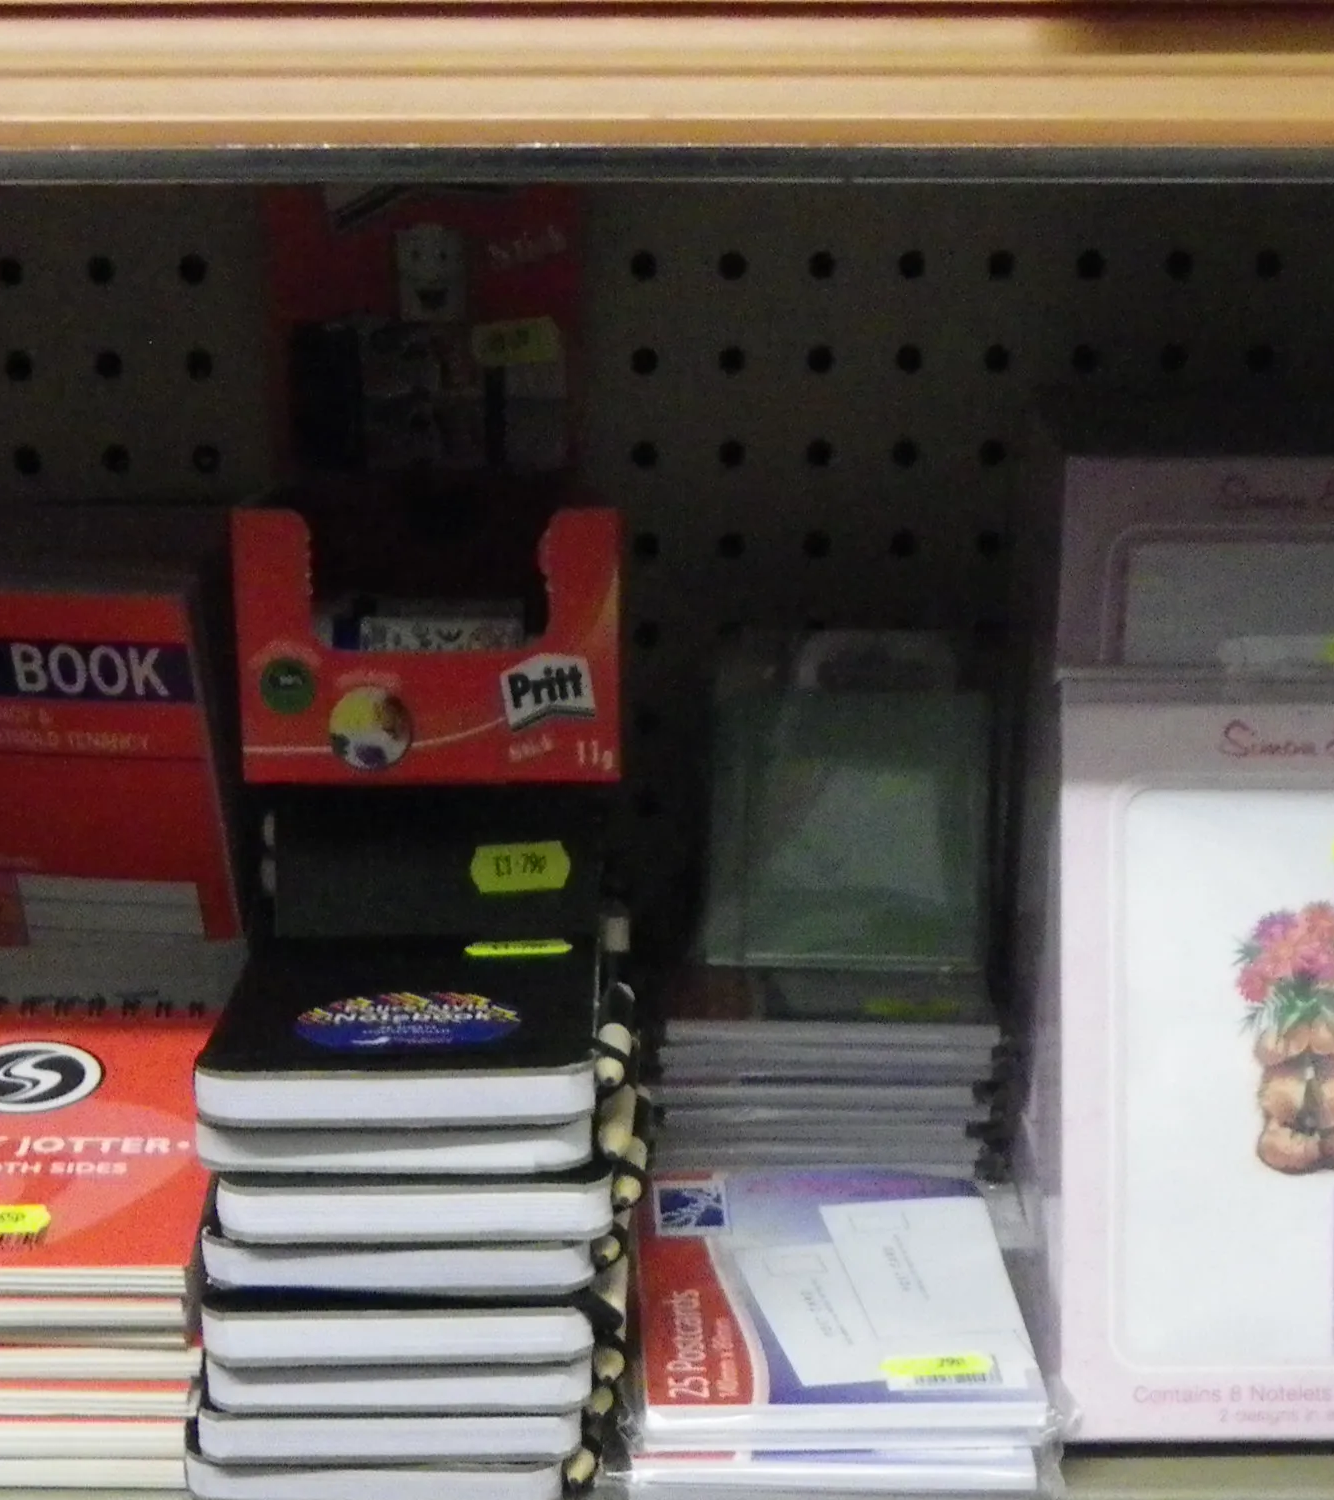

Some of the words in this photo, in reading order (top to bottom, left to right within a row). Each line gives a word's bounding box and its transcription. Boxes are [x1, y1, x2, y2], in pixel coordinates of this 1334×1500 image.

[9, 642, 170, 698] BOOK
[507, 663, 584, 709] Pritt
[575, 738, 616, 771] 11g
[1219, 717, 1317, 760] Simon
[15, 1135, 172, 1155] JOTTER
[49, 1160, 128, 1175] SIDES
[665, 1288, 709, 1372] Postcards
[668, 1376, 709, 1400] 25
[1132, 1384, 1223, 1405] Contains
[1250, 1384, 1332, 1402] Notelets
